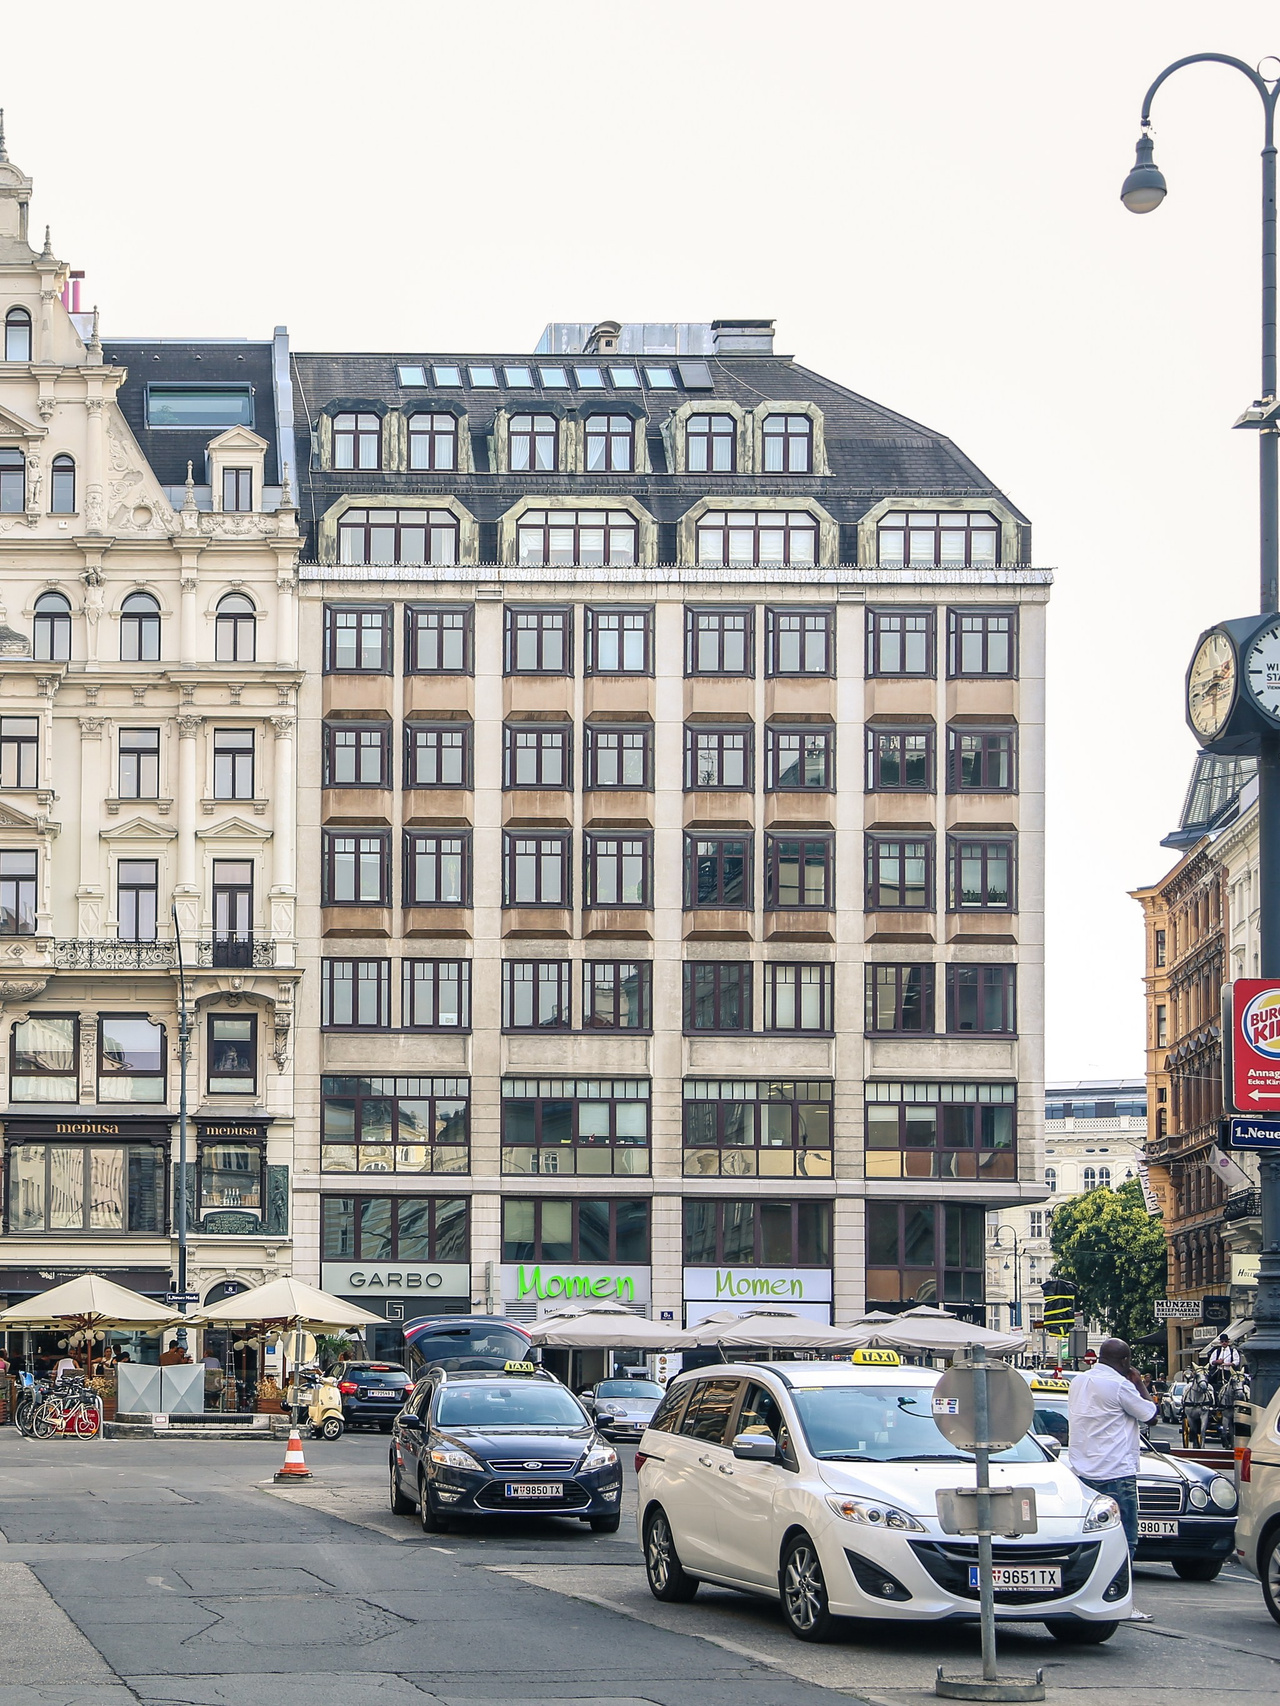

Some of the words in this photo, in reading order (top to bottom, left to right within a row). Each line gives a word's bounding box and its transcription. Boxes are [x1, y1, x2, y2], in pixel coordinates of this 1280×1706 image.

[1250, 1007, 1280, 1028] BUR
[349, 1271, 443, 1288] GARBO
[516, 1264, 635, 1302] Momen
[715, 1269, 803, 1299] Momen
[1155, 1299, 1200, 1308] MÜNZEN
[862, 1352, 895, 1362] TAXI
[509, 1362, 531, 1370] TAXI
[512, 1485, 519, 1495] W
[525, 1485, 548, 1495] 9850
[549, 1485, 561, 1495] TX
[1162, 1522, 1175, 1533] TX
[1002, 1570, 1036, 1585] 9651
[1038, 1570, 1056, 1585] TX
